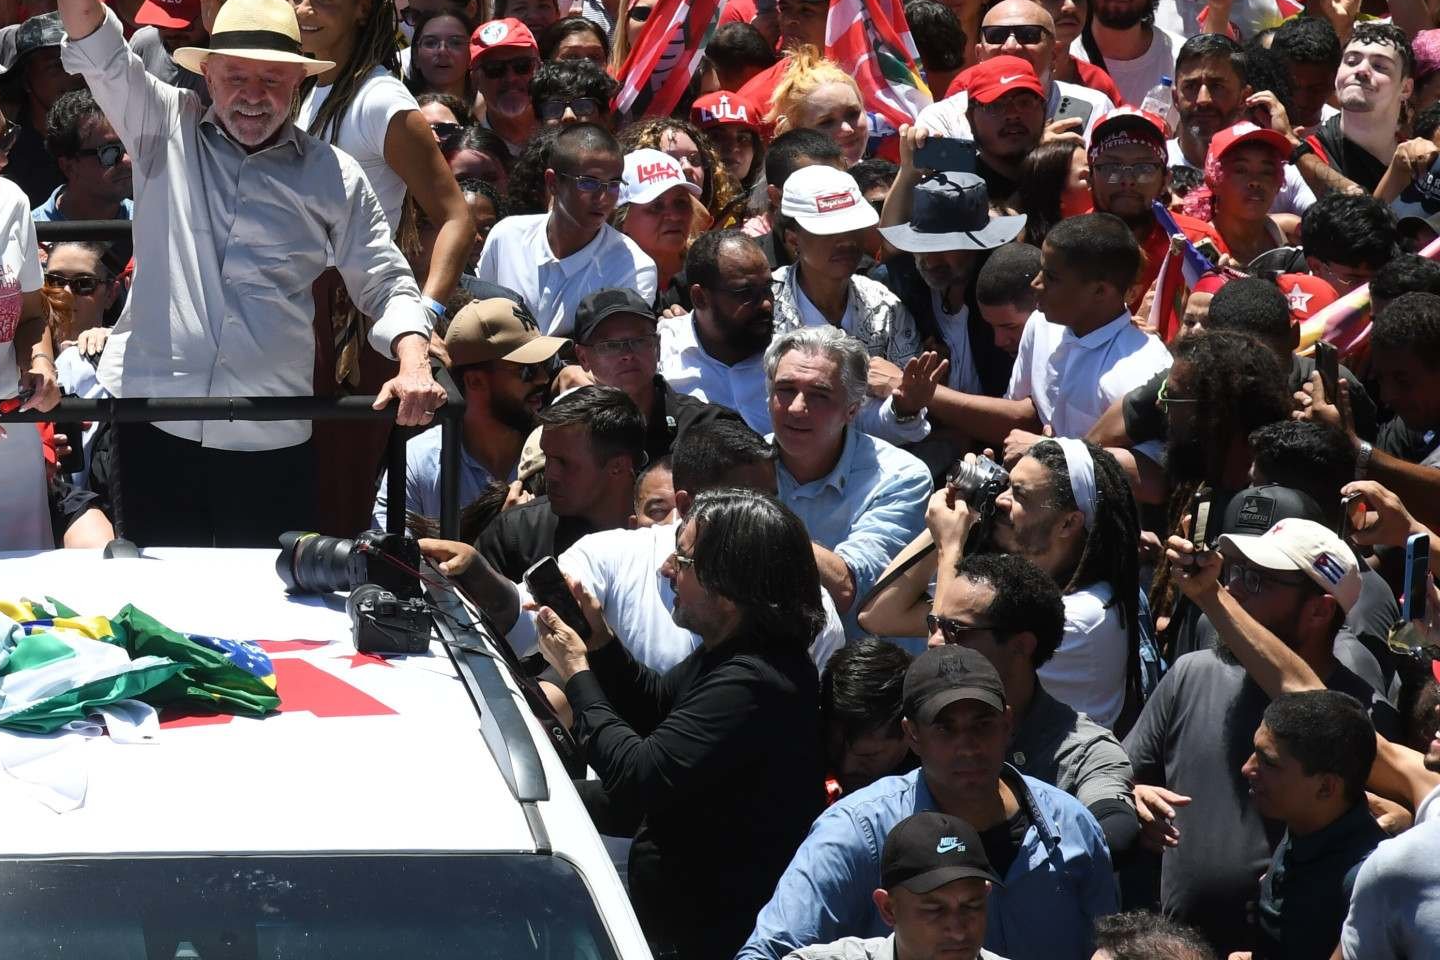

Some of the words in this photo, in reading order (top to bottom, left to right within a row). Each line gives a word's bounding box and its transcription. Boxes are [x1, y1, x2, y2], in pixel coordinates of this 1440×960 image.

[702, 103, 748, 123] LULA
[637, 161, 675, 184] LULA
[1290, 295, 1305, 307] PT
[941, 837, 958, 846] NIKE
